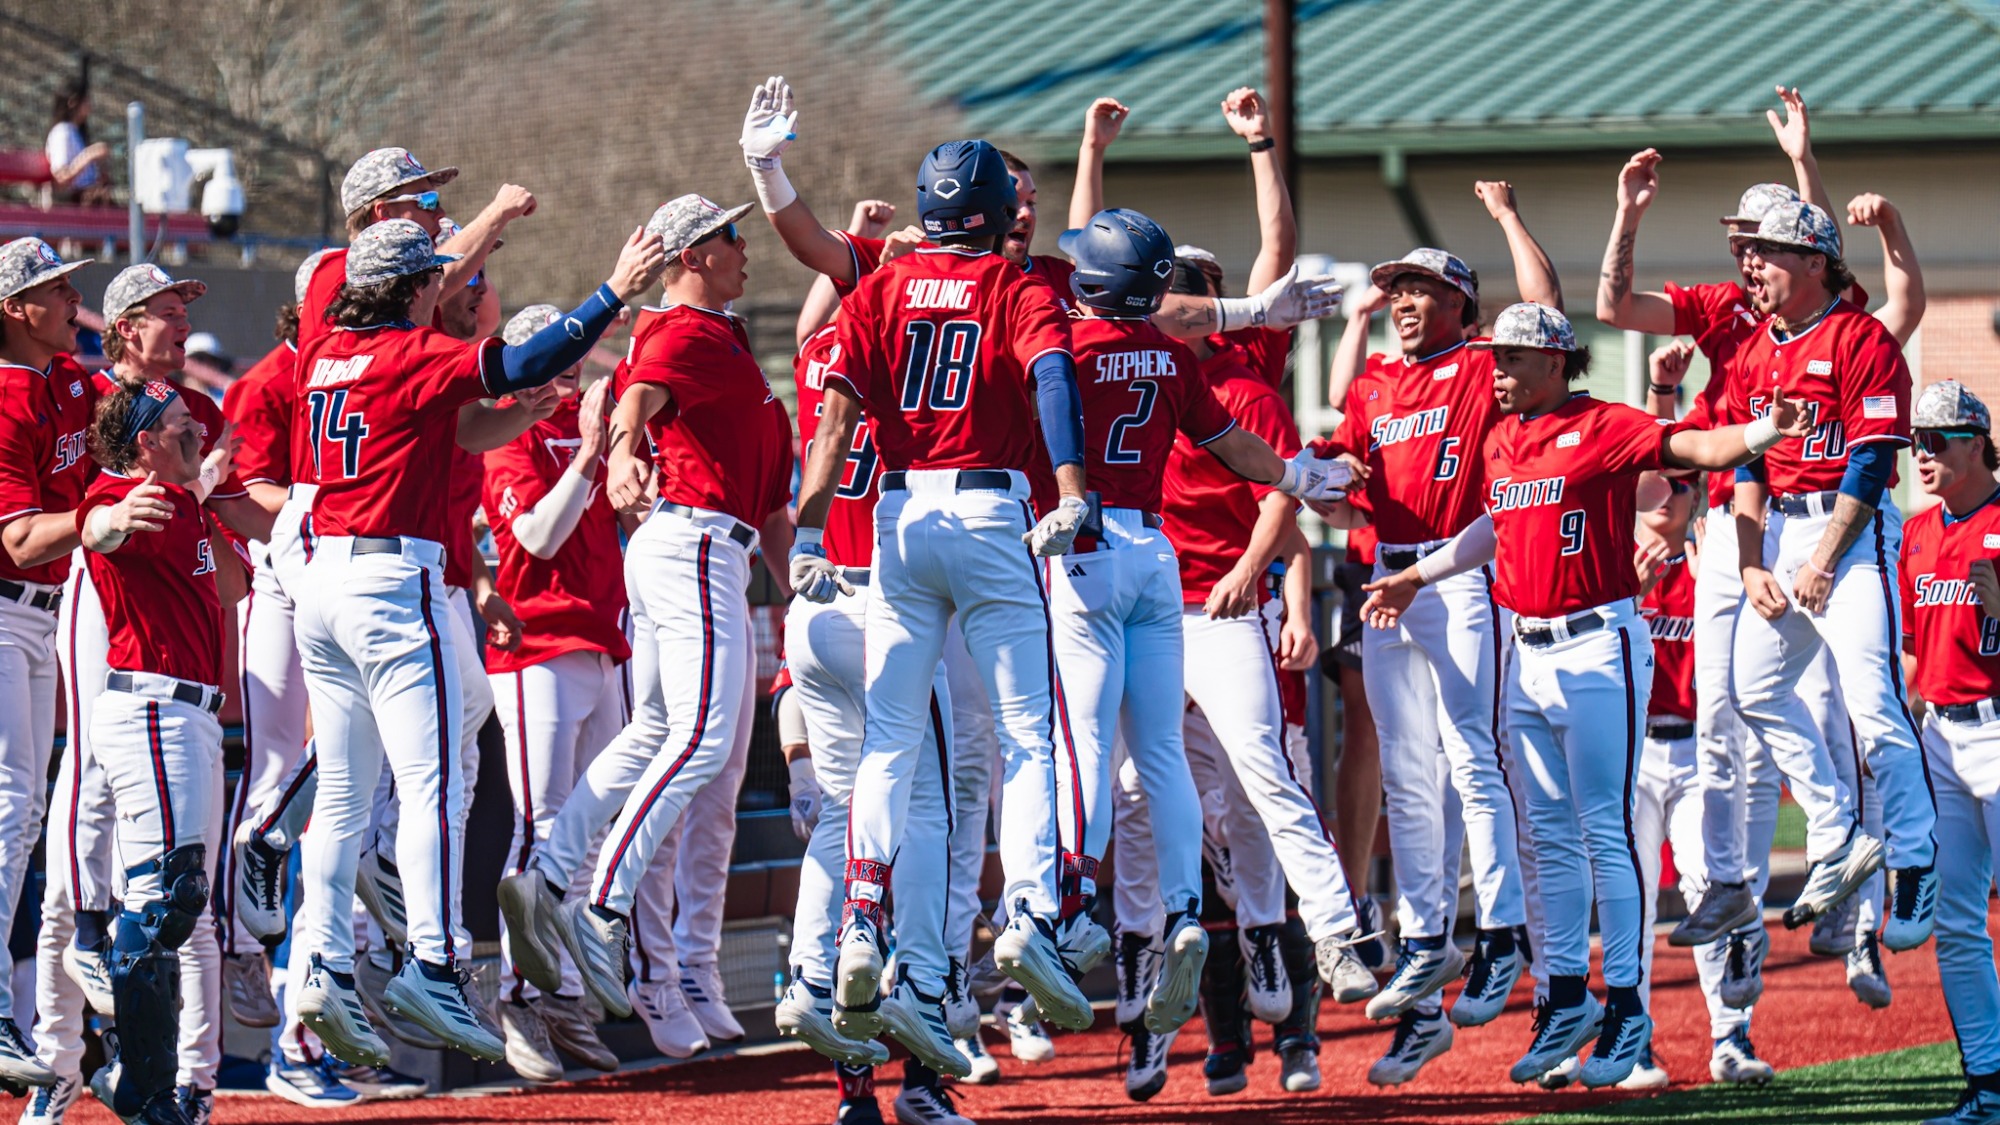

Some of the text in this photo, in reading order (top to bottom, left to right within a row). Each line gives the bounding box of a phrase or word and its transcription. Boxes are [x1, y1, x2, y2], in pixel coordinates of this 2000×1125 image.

[905, 278, 977, 310] YOUNG
[1125, 295, 1147, 308] SBC
[900, 320, 982, 412] 18
[1094, 350, 1177, 384] STEPHENS
[307, 388, 370, 480] 14
[1104, 379, 1159, 464] 2
[1369, 405, 1449, 453] SOUTH
[1801, 420, 1847, 462] 20
[1433, 436, 1461, 481] 6
[1490, 475, 1566, 514] SOUTH
[1559, 508, 1586, 557] 9
